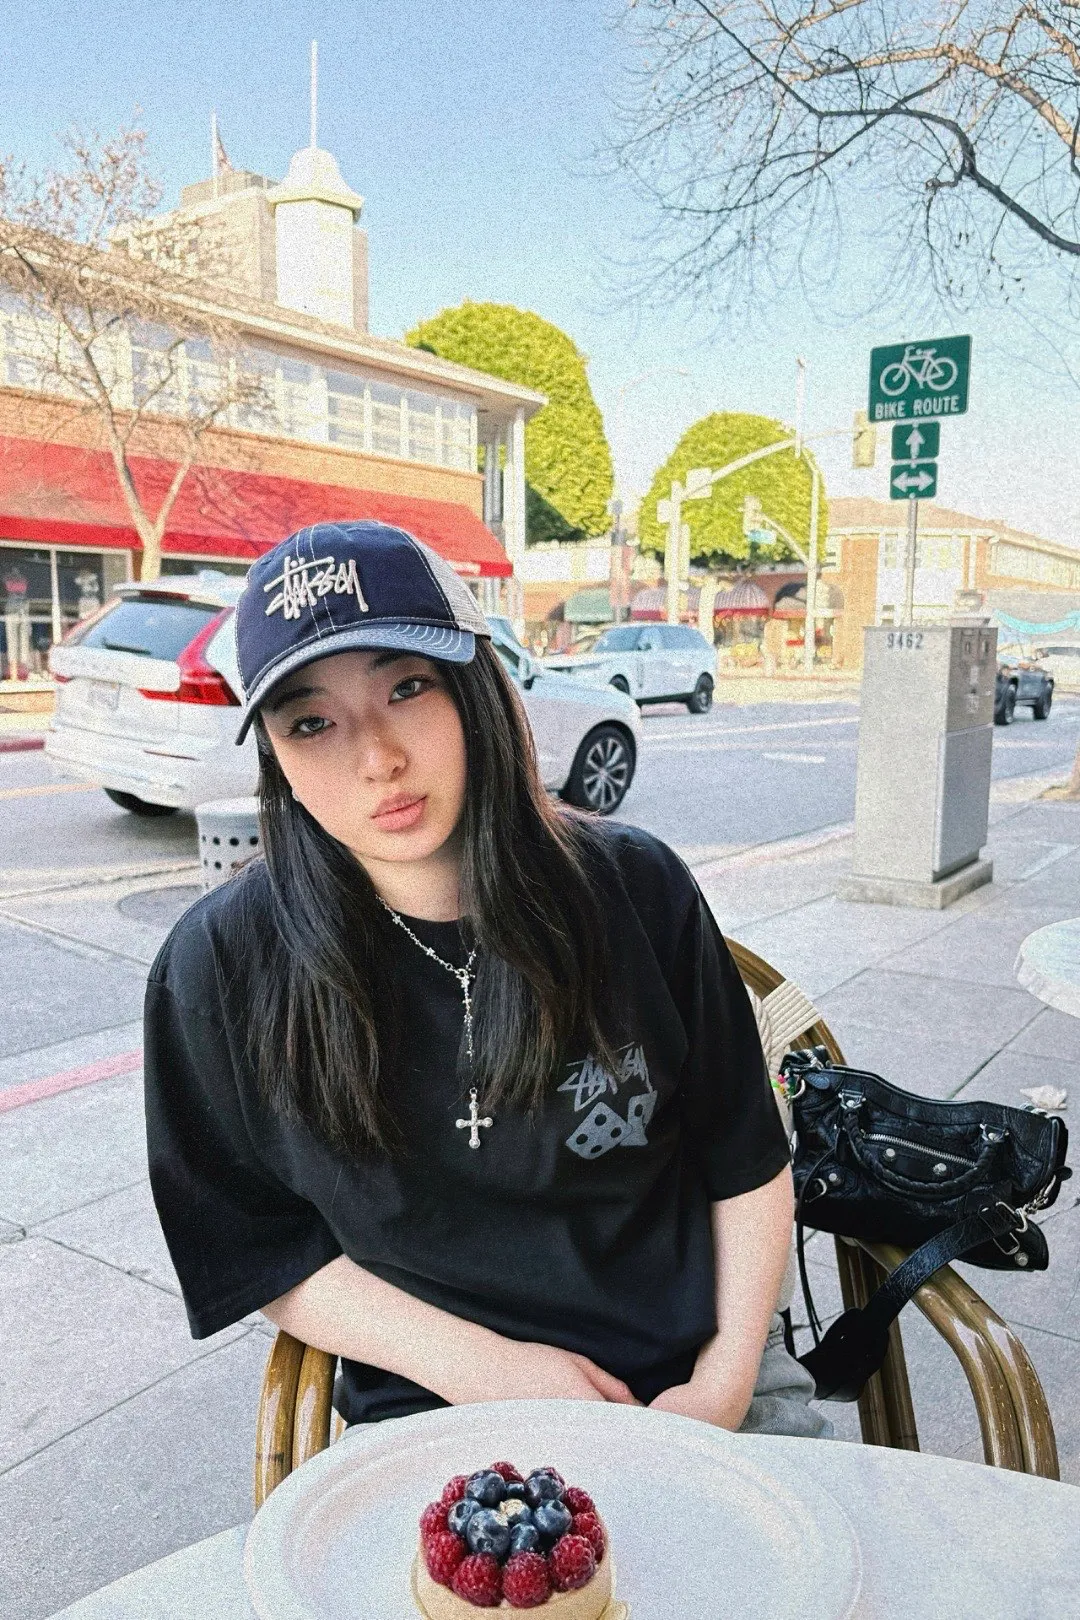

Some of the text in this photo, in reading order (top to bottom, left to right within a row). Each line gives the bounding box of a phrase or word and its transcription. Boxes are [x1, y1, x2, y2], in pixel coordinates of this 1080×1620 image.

[874, 395, 960, 419] BIKE ROUTE
[887, 632, 924, 650] 9462
